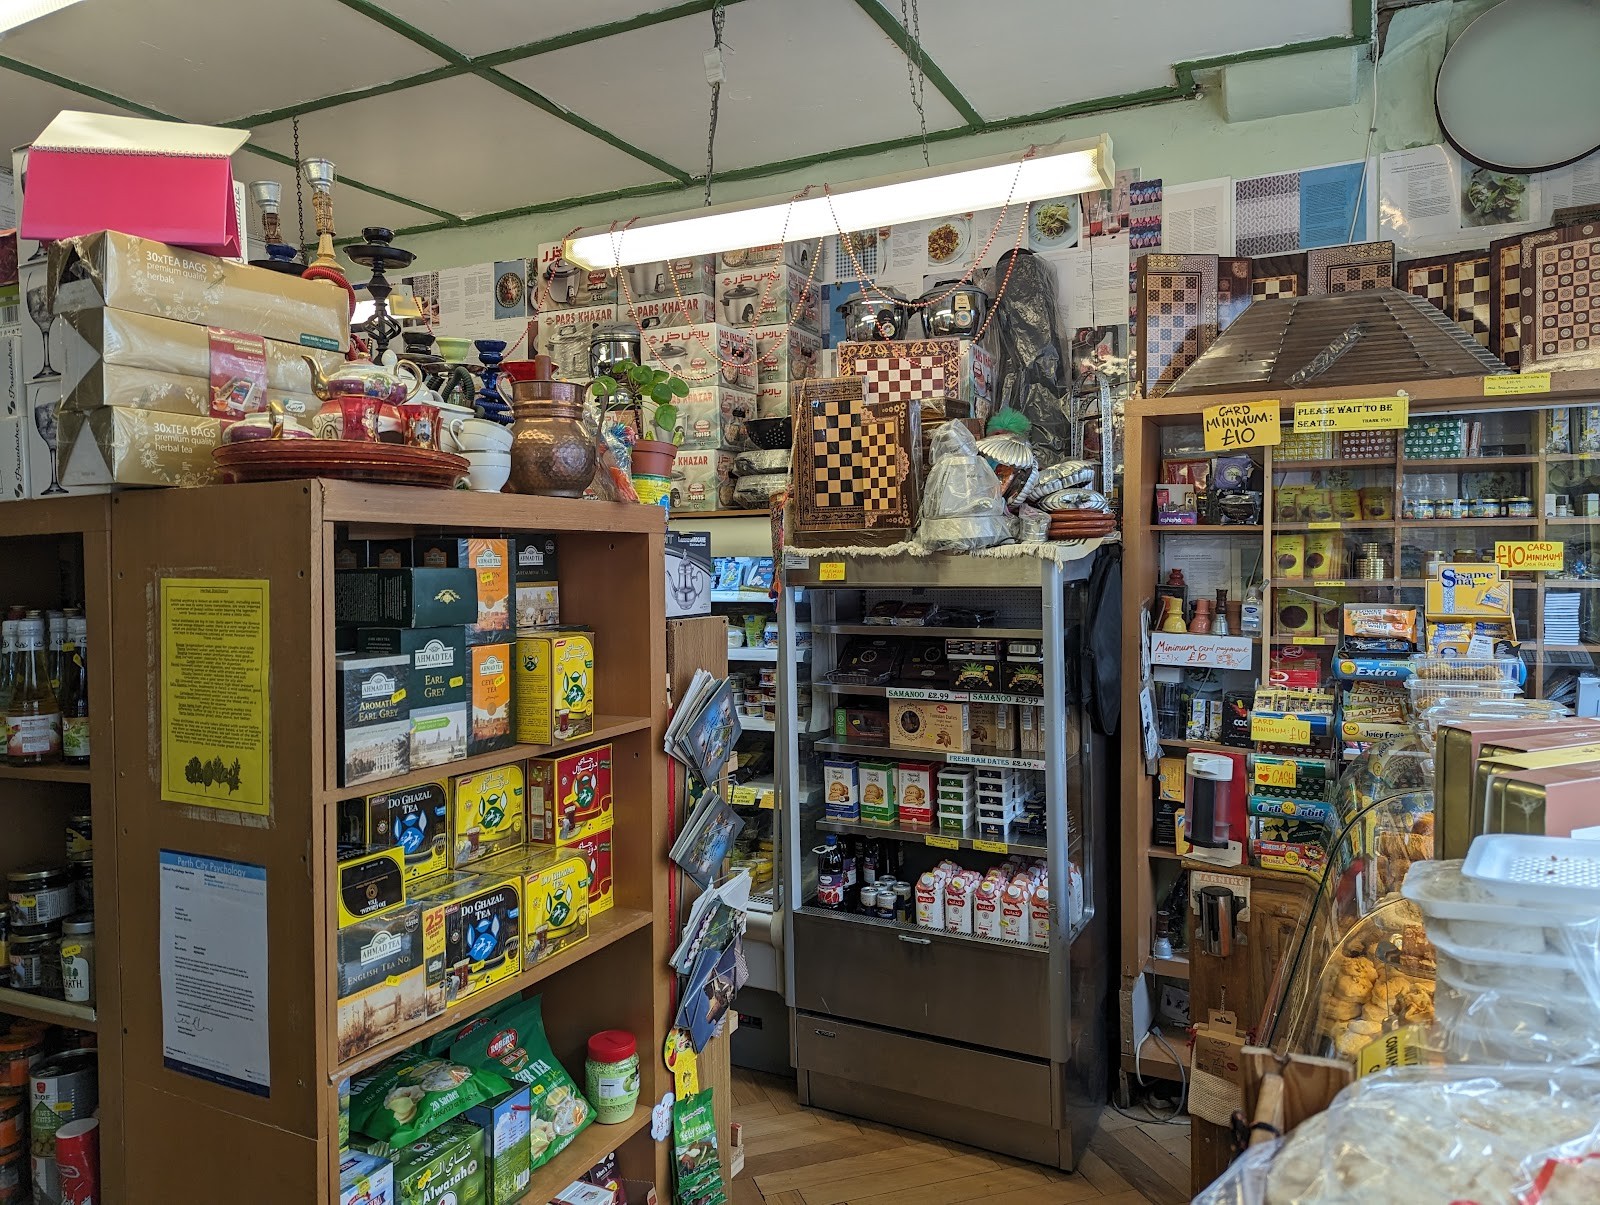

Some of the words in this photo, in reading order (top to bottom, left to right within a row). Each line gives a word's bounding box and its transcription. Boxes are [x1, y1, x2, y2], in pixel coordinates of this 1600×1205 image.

[146, 251, 180, 267] 30xTEA
[183, 260, 207, 273] BAGS
[147, 263, 182, 276] premium
[183, 270, 207, 282] quality
[147, 272, 174, 284] herbals
[638, 304, 659, 317] PARS
[662, 298, 698, 314] KHAZAR
[556, 313, 575, 325] PARS
[578, 309, 612, 322] KHAZAR
[683, 392, 712, 403] KHAZAR
[1218, 405, 1250, 416] CARD
[1298, 407, 1335, 416] PLEASE
[1337, 406, 1362, 414] WAIT
[1364, 404, 1377, 413] TO
[1380, 404, 1393, 412] BE
[1206, 414, 1273, 432] MINIMUM:
[1298, 419, 1337, 428] SEATED.
[154, 423, 189, 435] 30xTEA
[191, 427, 216, 438] BAGS
[1222, 428, 1255, 446] £10
[155, 434, 189, 443] premium
[192, 438, 216, 447] quality
[156, 443, 179, 452] herbal
[181, 446, 192, 454] tea
[678, 456, 708, 466] KHAZAR
[1496, 544, 1525, 568] £10
[1527, 543, 1552, 551] CARD
[1526, 552, 1562, 561] MINIMUM!
[1442, 569, 1493, 582] Sesame
[1155, 641, 1197, 652] Minimum
[1198, 644, 1215, 652] card
[1216, 646, 1249, 654] payment
[416, 653, 440, 663] AHMAD
[441, 651, 453, 661] TEA
[1187, 652, 1208, 662] £10
[1356, 668, 1397, 676] Extra
[425, 675, 444, 685] EARL
[362, 684, 382, 692] AHMAD
[424, 687, 445, 698] GREY
[928, 692, 949, 700] £2.99
[972, 693, 1012, 702] SAMANOO
[358, 711, 377, 722] EARL
[379, 708, 398, 718] GREY
[1289, 727, 1308, 741] £10
[1272, 770, 1294, 784] CASH
[388, 798, 400, 809] DO
[402, 791, 432, 804] GHAZAL
[402, 804, 418, 814] TEA
[177, 856, 194, 868] Perth
[195, 860, 208, 871] City
[210, 862, 246, 878] Psychology
[1194, 873, 1245, 885] WARNING
[360, 904, 379, 914] GHAZAL
[461, 906, 473, 917] DO
[474, 894, 504, 910] GHAZAL
[426, 908, 443, 932] 25
[475, 909, 491, 920] TEA
[362, 944, 387, 959] AHMAD
[388, 940, 400, 948] TEA
[348, 968, 378, 986] ENGLISH
[381, 962, 395, 971] TEA
[490, 1033, 515, 1053] ROBERTS
[529, 1059, 552, 1076] TEA
[430, 1100, 440, 1112] 20
[424, 1166, 467, 1204] Alwazah
